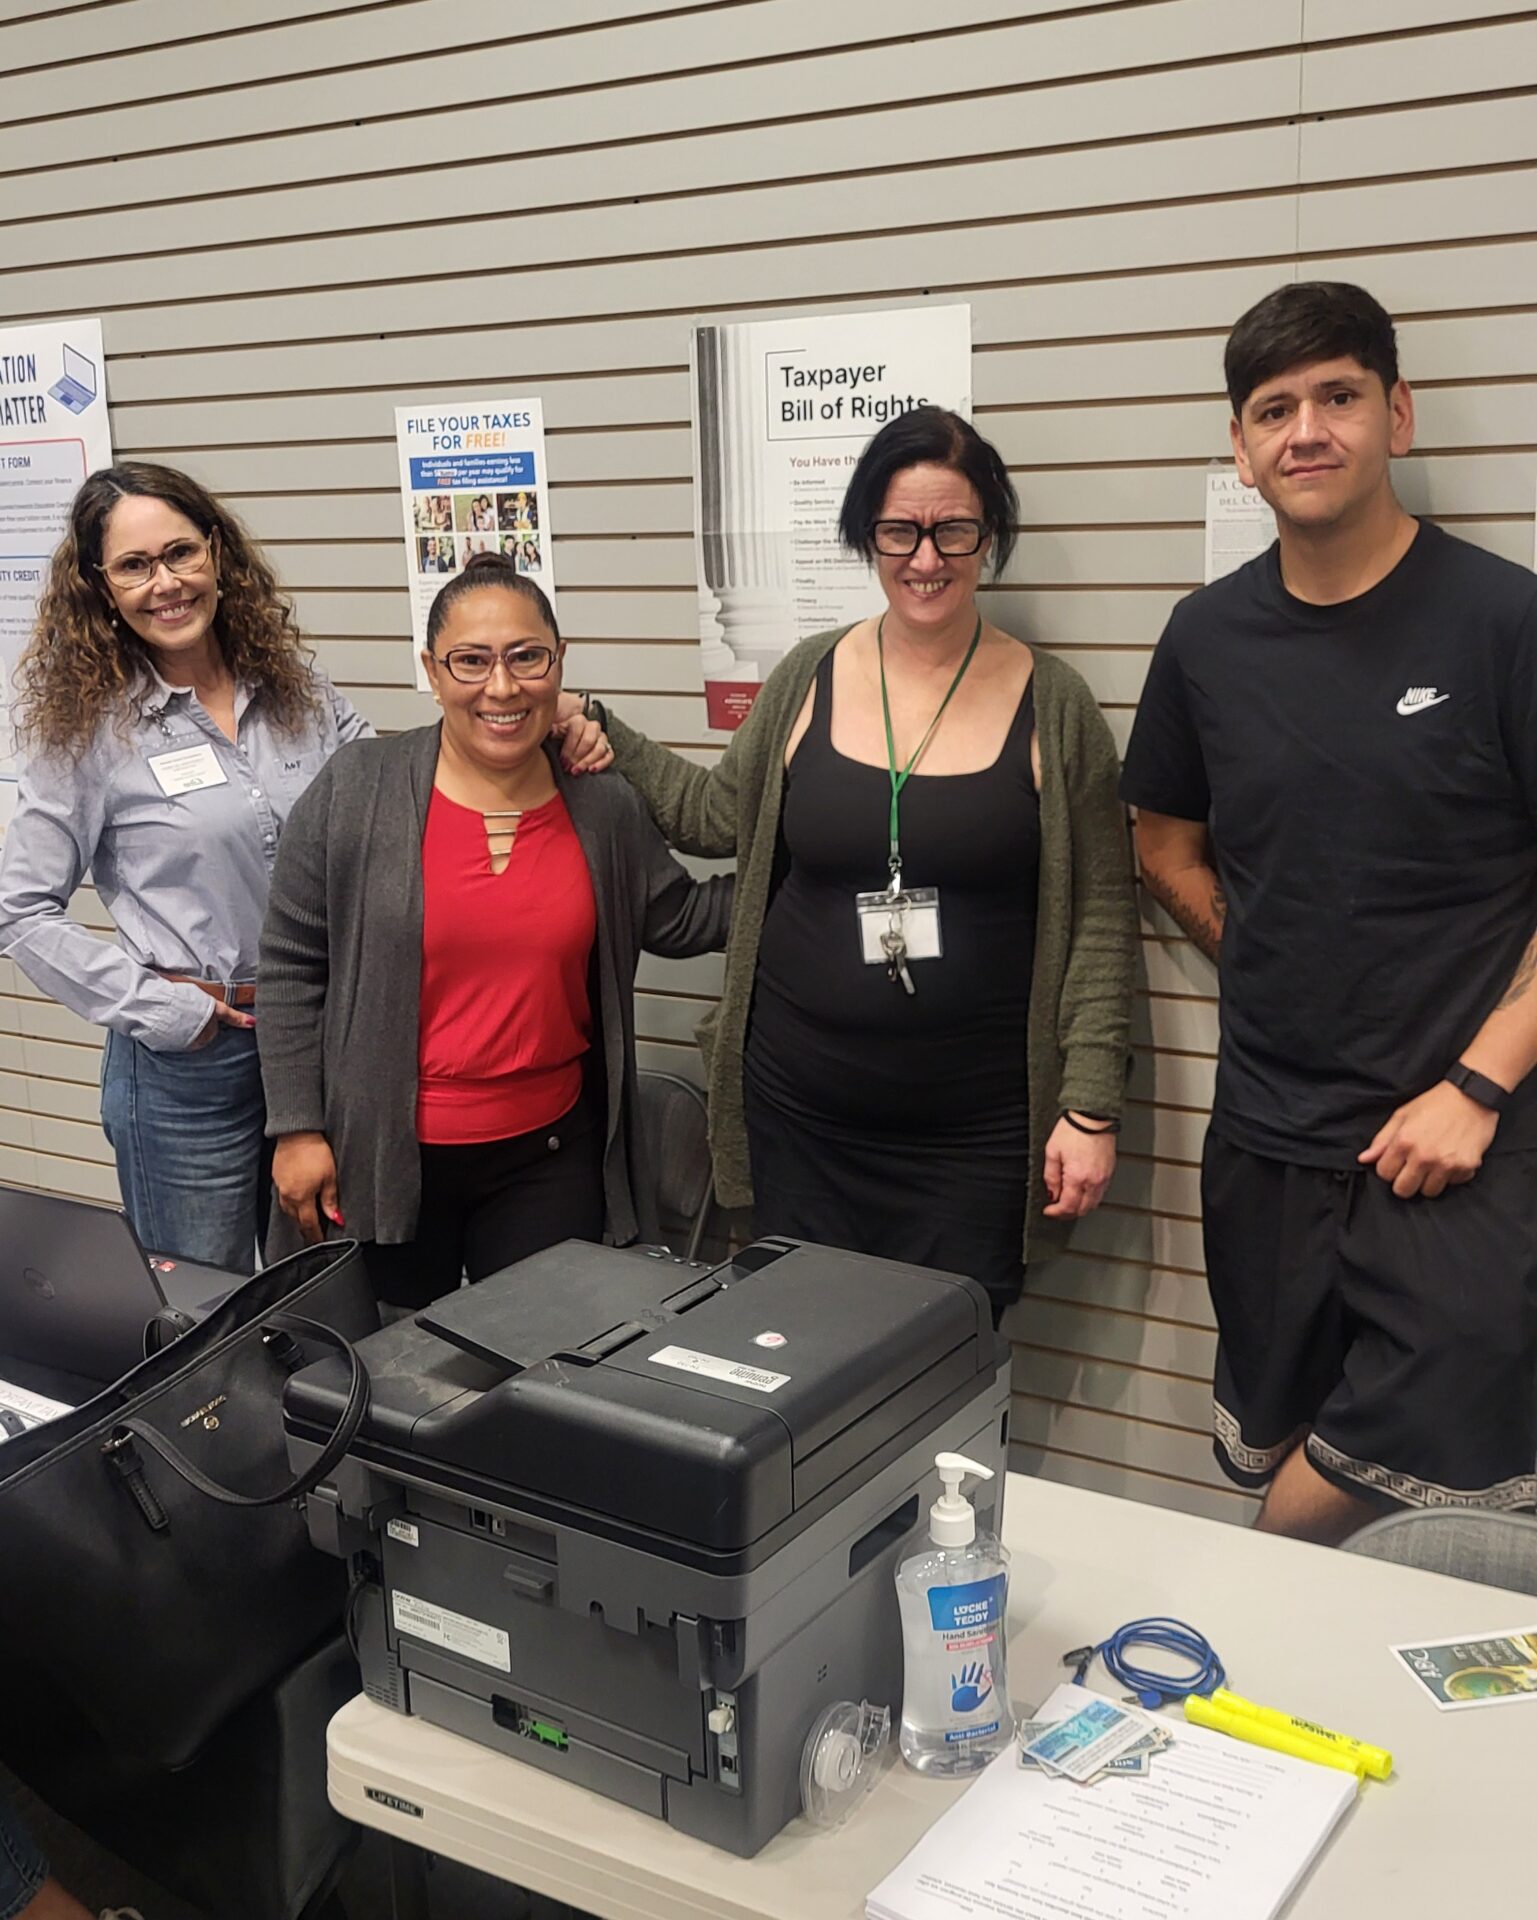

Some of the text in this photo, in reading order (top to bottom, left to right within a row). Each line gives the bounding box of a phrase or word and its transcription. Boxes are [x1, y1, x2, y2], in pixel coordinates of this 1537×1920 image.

[780, 363, 886, 390] Taxpayer
[781, 394, 929, 422] Bill of Rights
[407, 412, 531, 434] FILE YOUR TAXES
[433, 431, 507, 450] FOR FREE!
[8, 456, 31, 469] FORM
[789, 457, 810, 468] You
[812, 456, 841, 467] Have
[1211, 479, 1227, 491] LA
[1219, 495, 1264, 506] DEL CO
[13, 570, 40, 582] CREDIT
[1404, 686, 1438, 705] NIKE
[728, 1368, 780, 1385] genuine
[953, 1611, 989, 1626] TEDDY
[942, 1630, 965, 1642] Hand
[371, 1789, 416, 1815] LIFETIME
